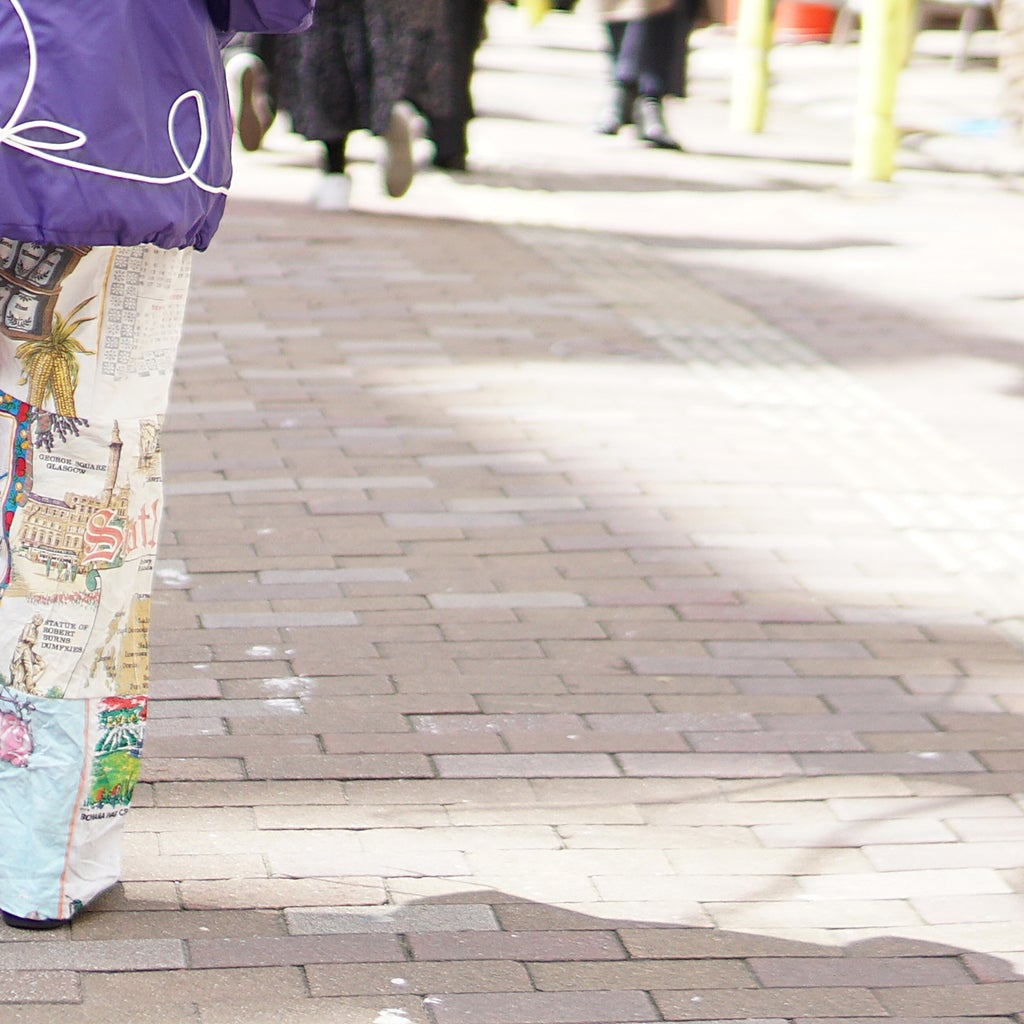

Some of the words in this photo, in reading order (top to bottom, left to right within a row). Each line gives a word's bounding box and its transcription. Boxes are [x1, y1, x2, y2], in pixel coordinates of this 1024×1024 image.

[38, 453, 72, 465] GEORGE
[75, 461, 108, 472] SQUARE
[46, 462, 87, 475] GLASGOW
[44, 618, 76, 630] STATUE
[42, 626, 76, 637] ROBERT
[42, 634, 71, 644] BURNS
[40, 642, 83, 653] DUMFRIES
